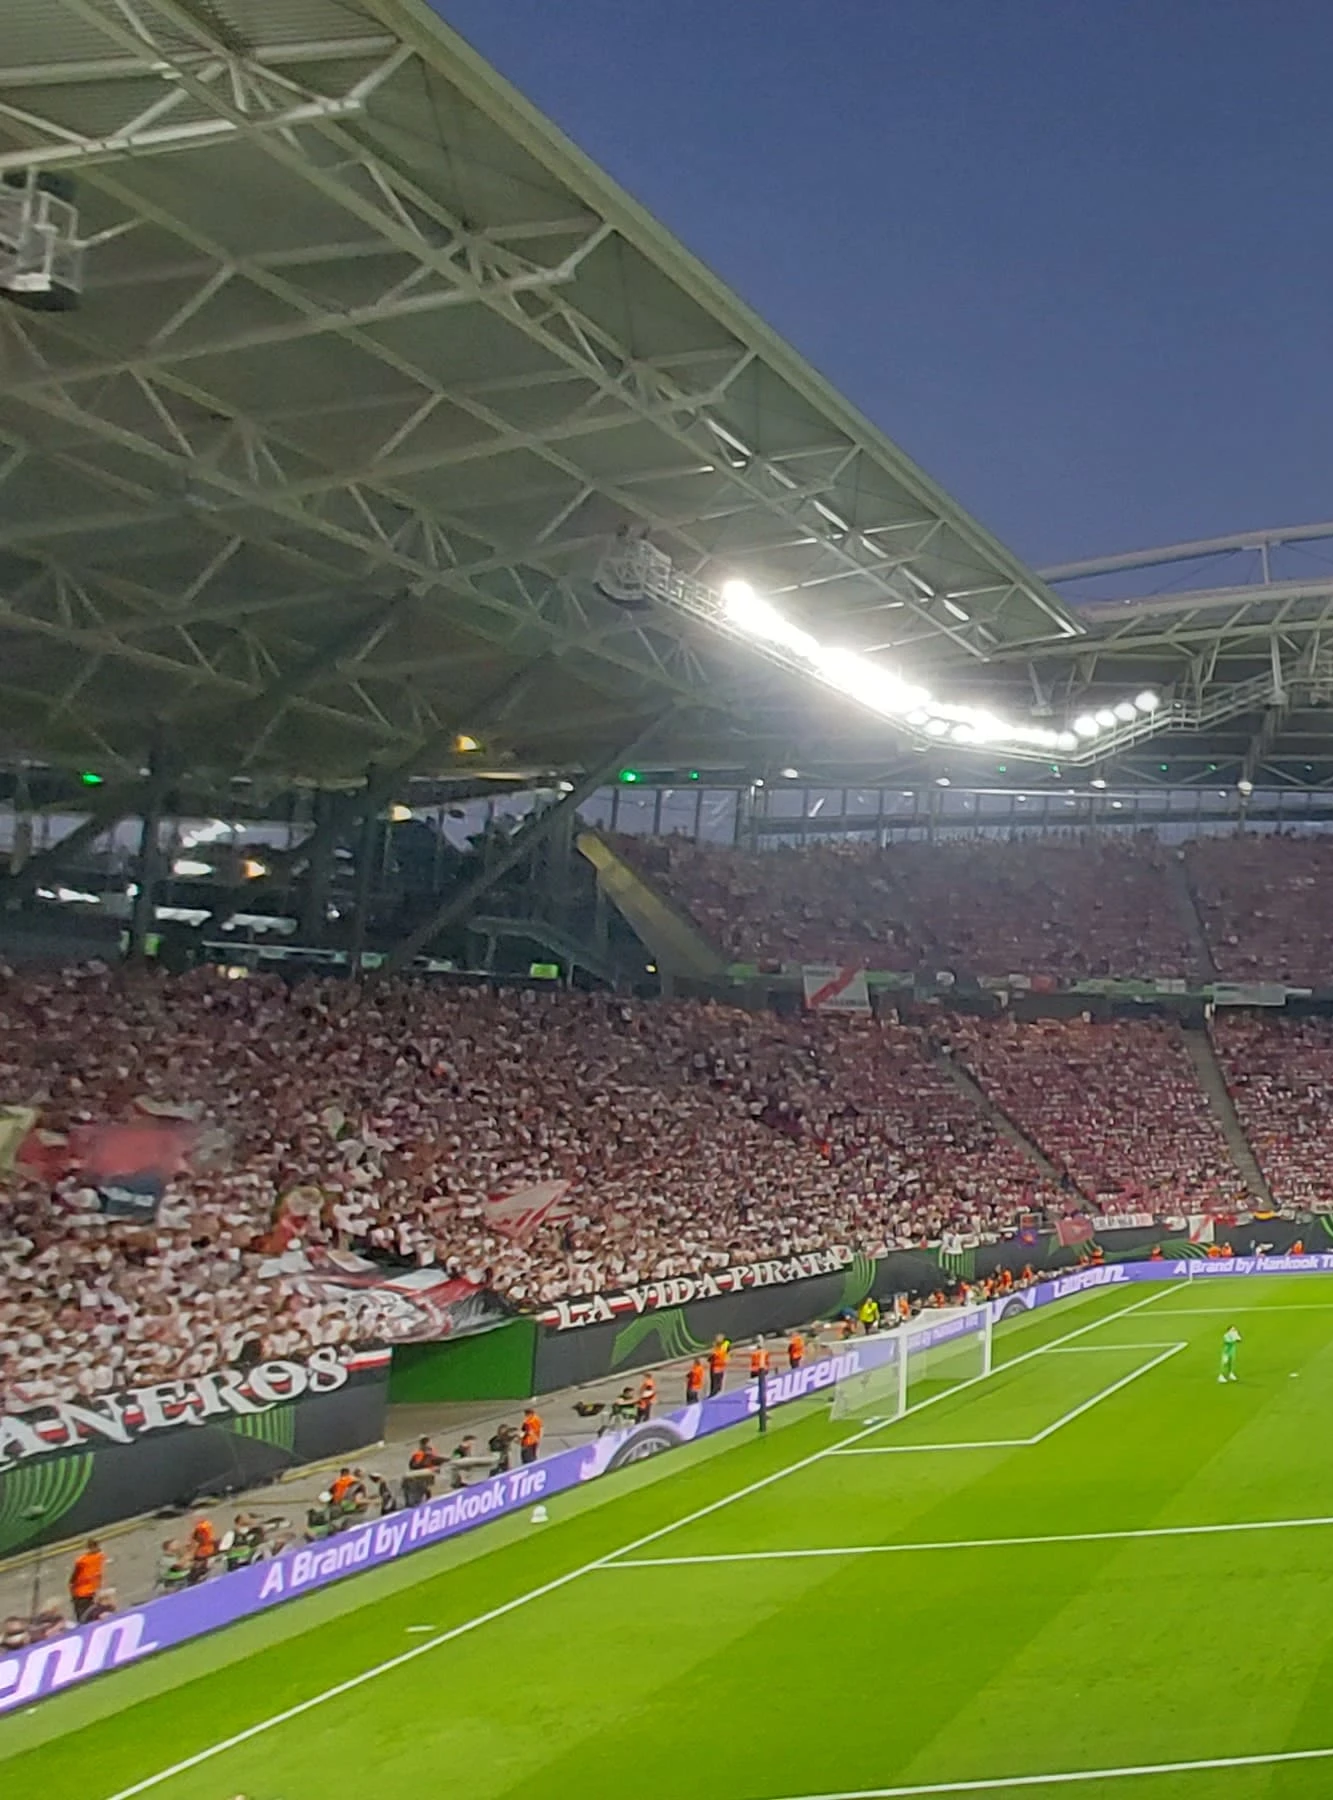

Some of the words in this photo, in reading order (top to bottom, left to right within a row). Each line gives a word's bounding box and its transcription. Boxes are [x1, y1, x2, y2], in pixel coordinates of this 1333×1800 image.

[555, 1294, 617, 1331] LA
[624, 1272, 723, 1314] VIDA
[726, 1249, 846, 1293] PIRATA
[1190, 1258, 1234, 1274] Brand
[1235, 1258, 1255, 1274] by
[1256, 1255, 1318, 1271] Hankook
[258, 1562, 284, 1599] A
[290, 1526, 373, 1588] Brand
[375, 1518, 408, 1560] by
[409, 1484, 506, 1541] Hankook
[509, 1467, 547, 1502] Tire
